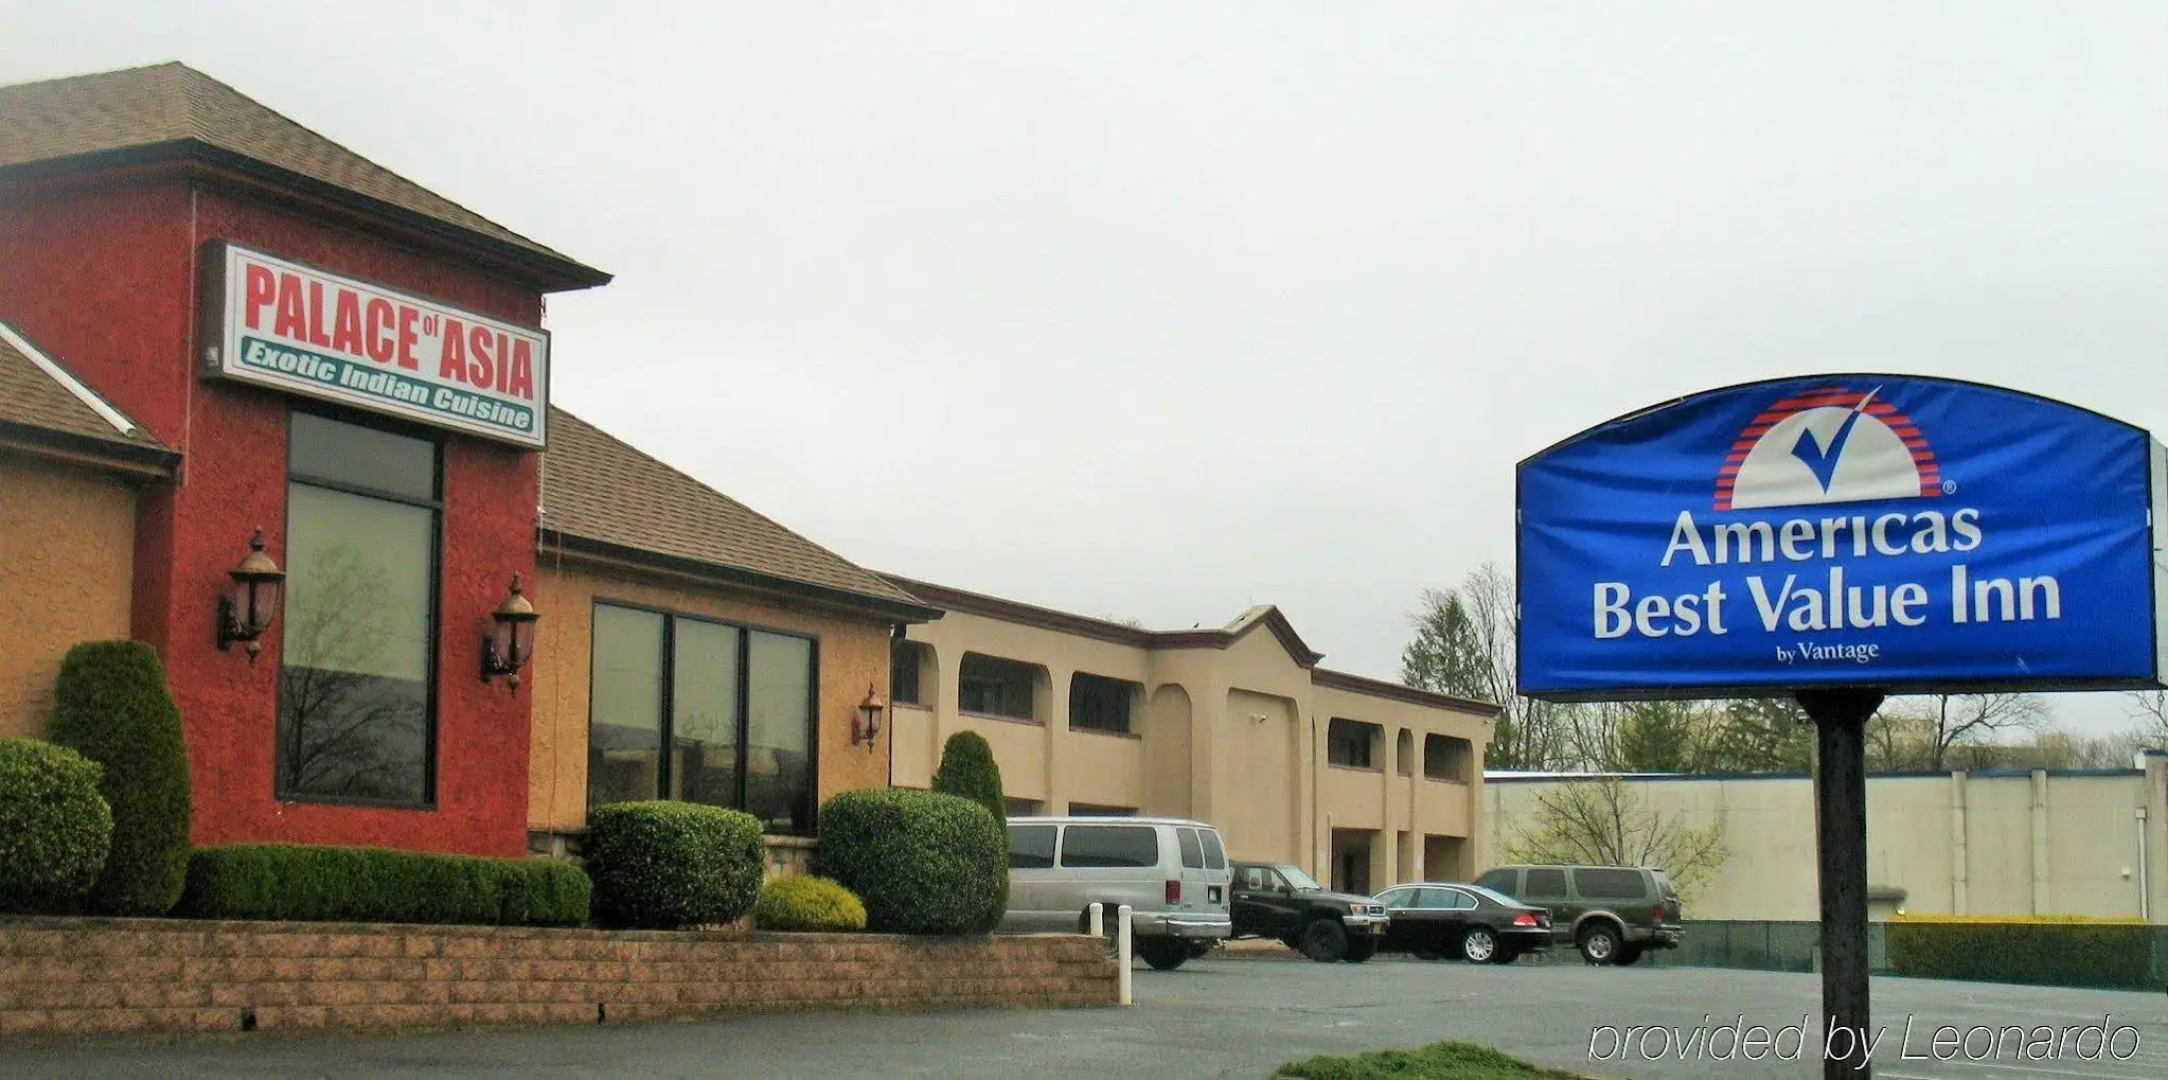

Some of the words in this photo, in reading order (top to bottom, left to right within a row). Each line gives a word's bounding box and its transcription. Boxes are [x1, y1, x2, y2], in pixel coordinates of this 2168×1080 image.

[246, 264, 419, 370] PALACE
[423, 314, 439, 337] of
[439, 319, 534, 400] ASIA
[246, 342, 335, 381] Exotic
[340, 368, 429, 403] Indian
[434, 391, 530, 428] Cuisine
[1661, 508, 1983, 567] Americas
[1593, 579, 1728, 640] Best
[1747, 565, 1928, 633] Value
[1952, 564, 2062, 624] Inn
[1776, 645, 1797, 663] by
[1797, 641, 1880, 664] Vantage
